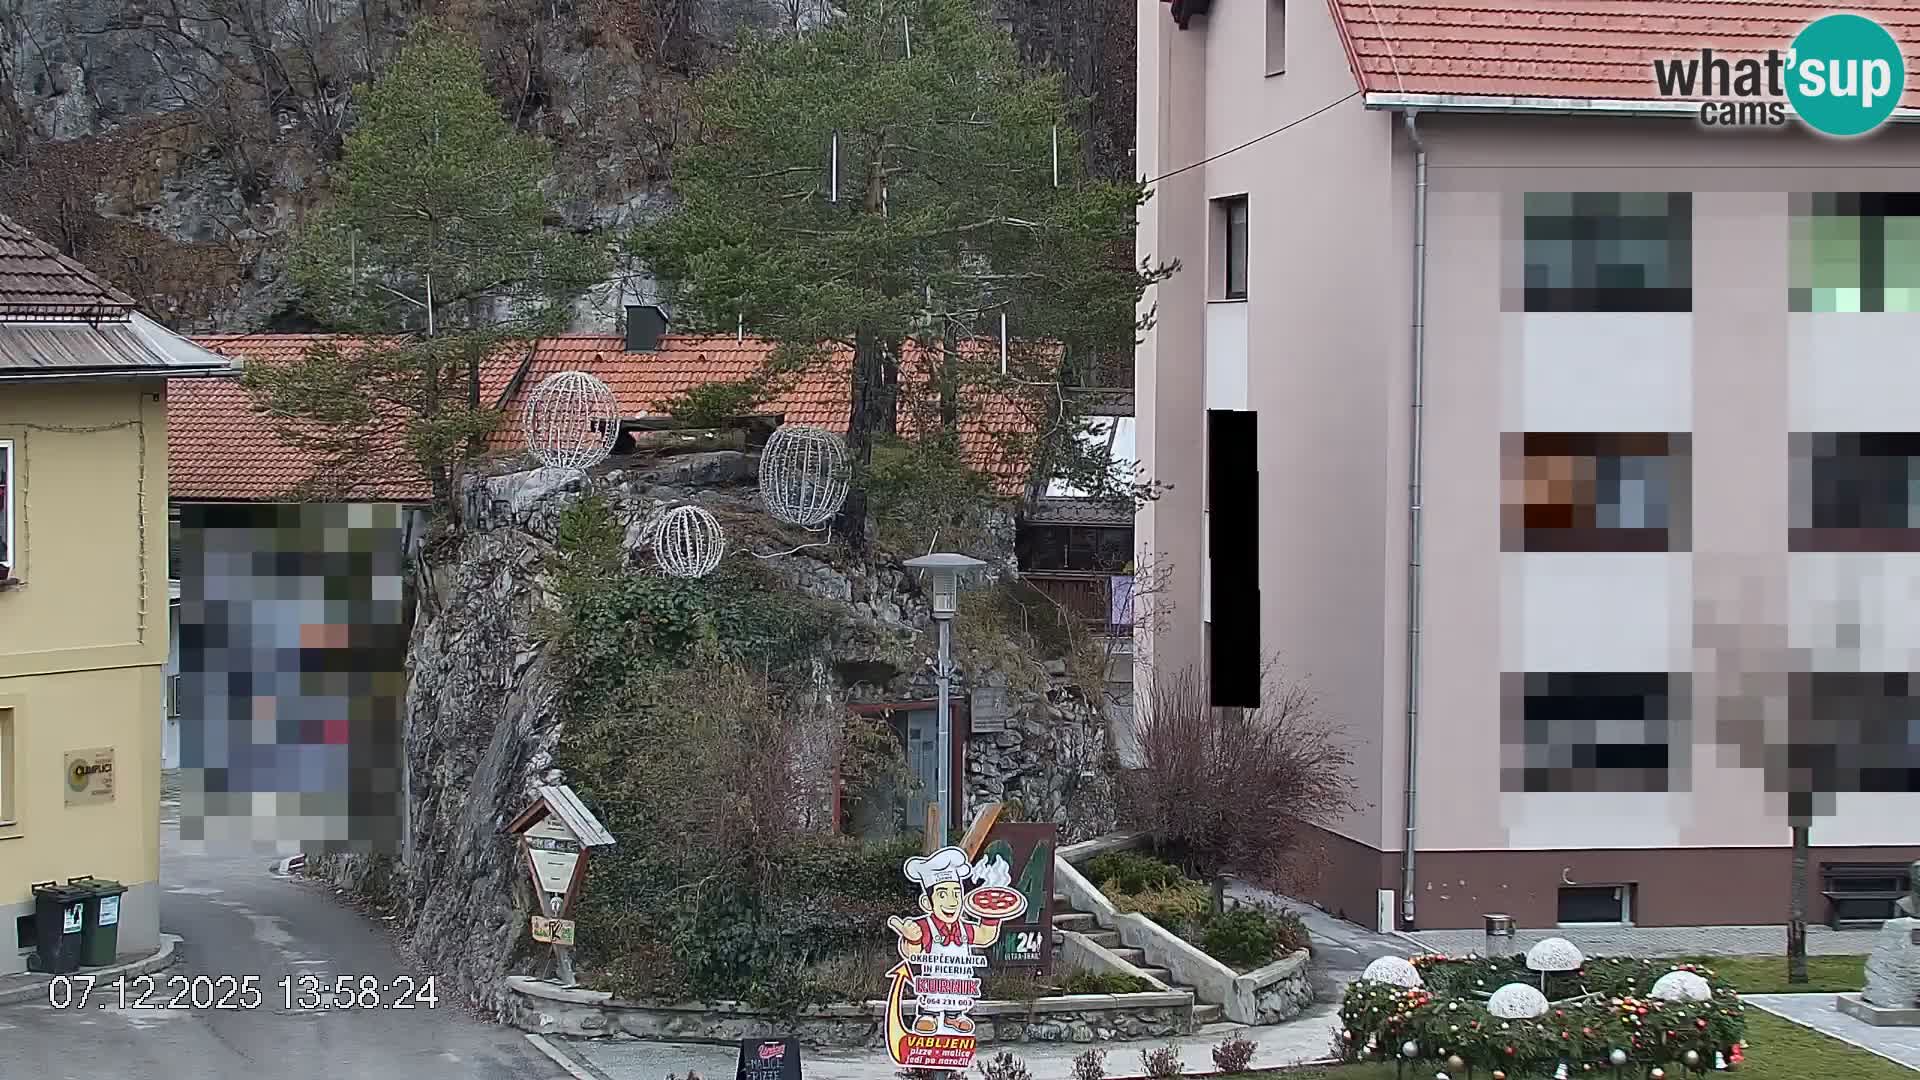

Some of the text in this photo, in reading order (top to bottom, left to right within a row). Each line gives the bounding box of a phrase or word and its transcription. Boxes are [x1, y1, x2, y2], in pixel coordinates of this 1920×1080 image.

[910, 953, 987, 966] OKREPČEVALNICA
[923, 965, 972, 975] IN PICERIJA
[916, 978, 977, 995] KURNIK
[907, 1036, 975, 1049] VABLJENI
[910, 1047, 932, 1056] pizze
